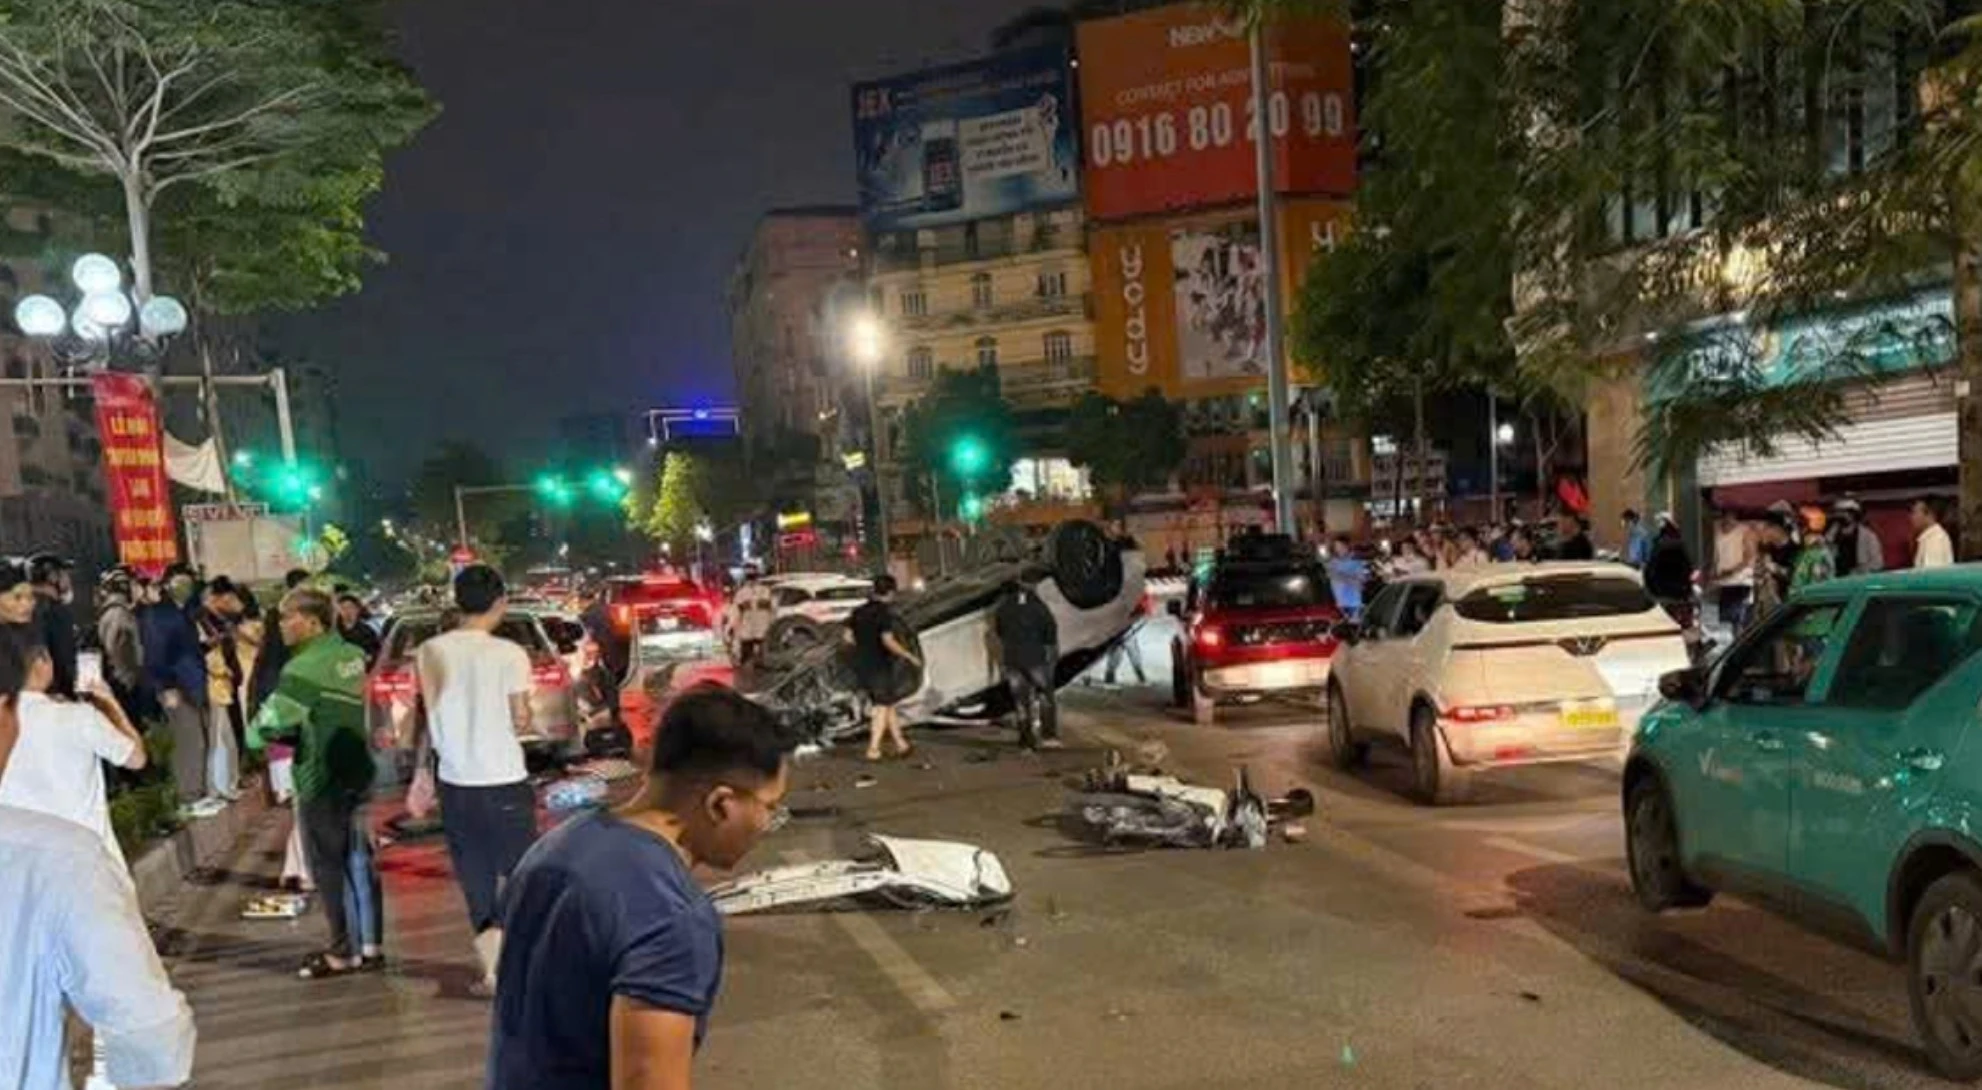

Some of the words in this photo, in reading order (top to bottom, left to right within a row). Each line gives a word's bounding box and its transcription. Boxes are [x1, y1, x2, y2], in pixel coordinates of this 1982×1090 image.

[1092, 112, 1177, 168] 0916
[1188, 101, 1232, 151] 80
[1300, 91, 1343, 138] 99
